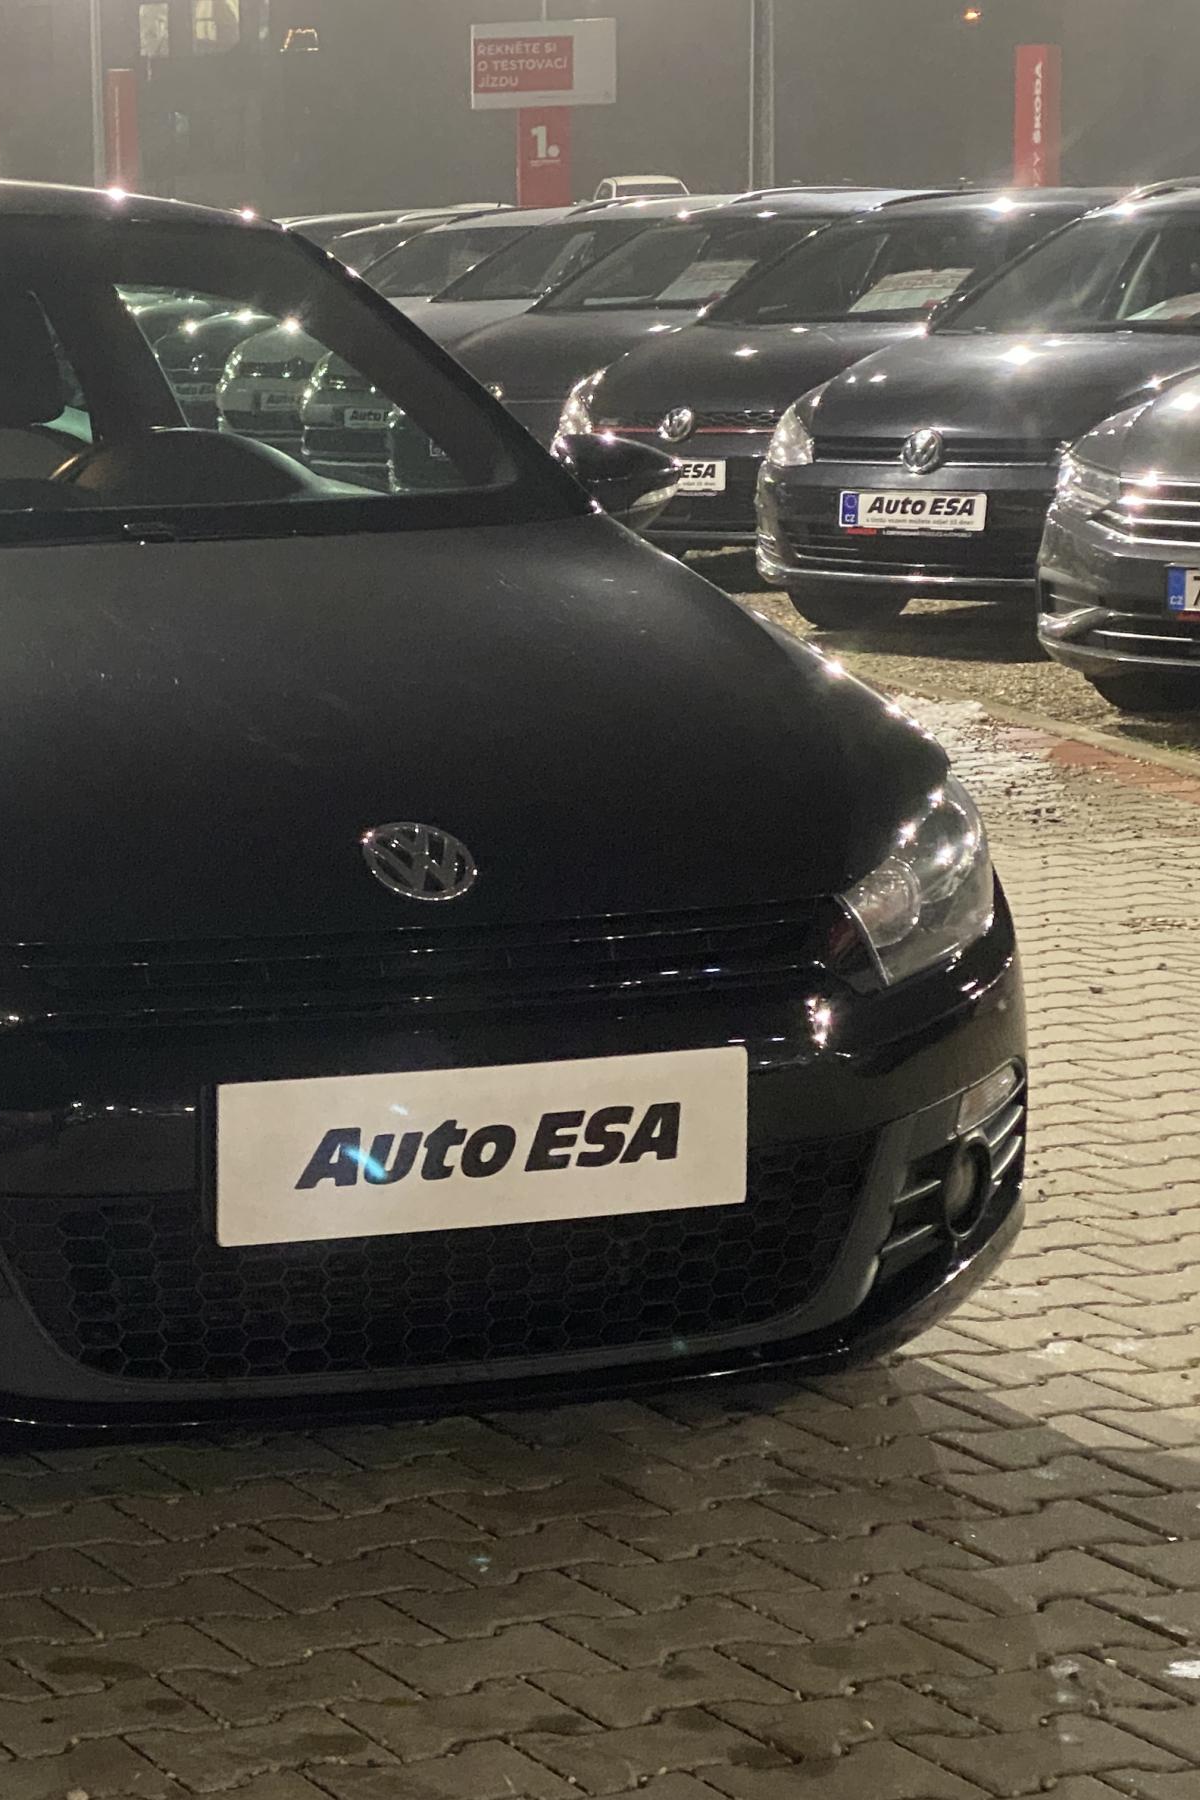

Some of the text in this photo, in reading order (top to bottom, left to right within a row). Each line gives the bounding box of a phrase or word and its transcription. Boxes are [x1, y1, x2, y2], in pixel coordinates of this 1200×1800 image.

[477, 41, 557, 56] ŘEKNĚTE SI
[477, 56, 568, 72] O TESTOVACÍ
[478, 73, 519, 88] JÍZDU
[530, 125, 560, 158] 1.
[680, 463, 716, 478] ESA
[867, 496, 976, 517] Auto ESA
[844, 513, 856, 523] CZ
[295, 1102, 681, 1190] Auto ESA
